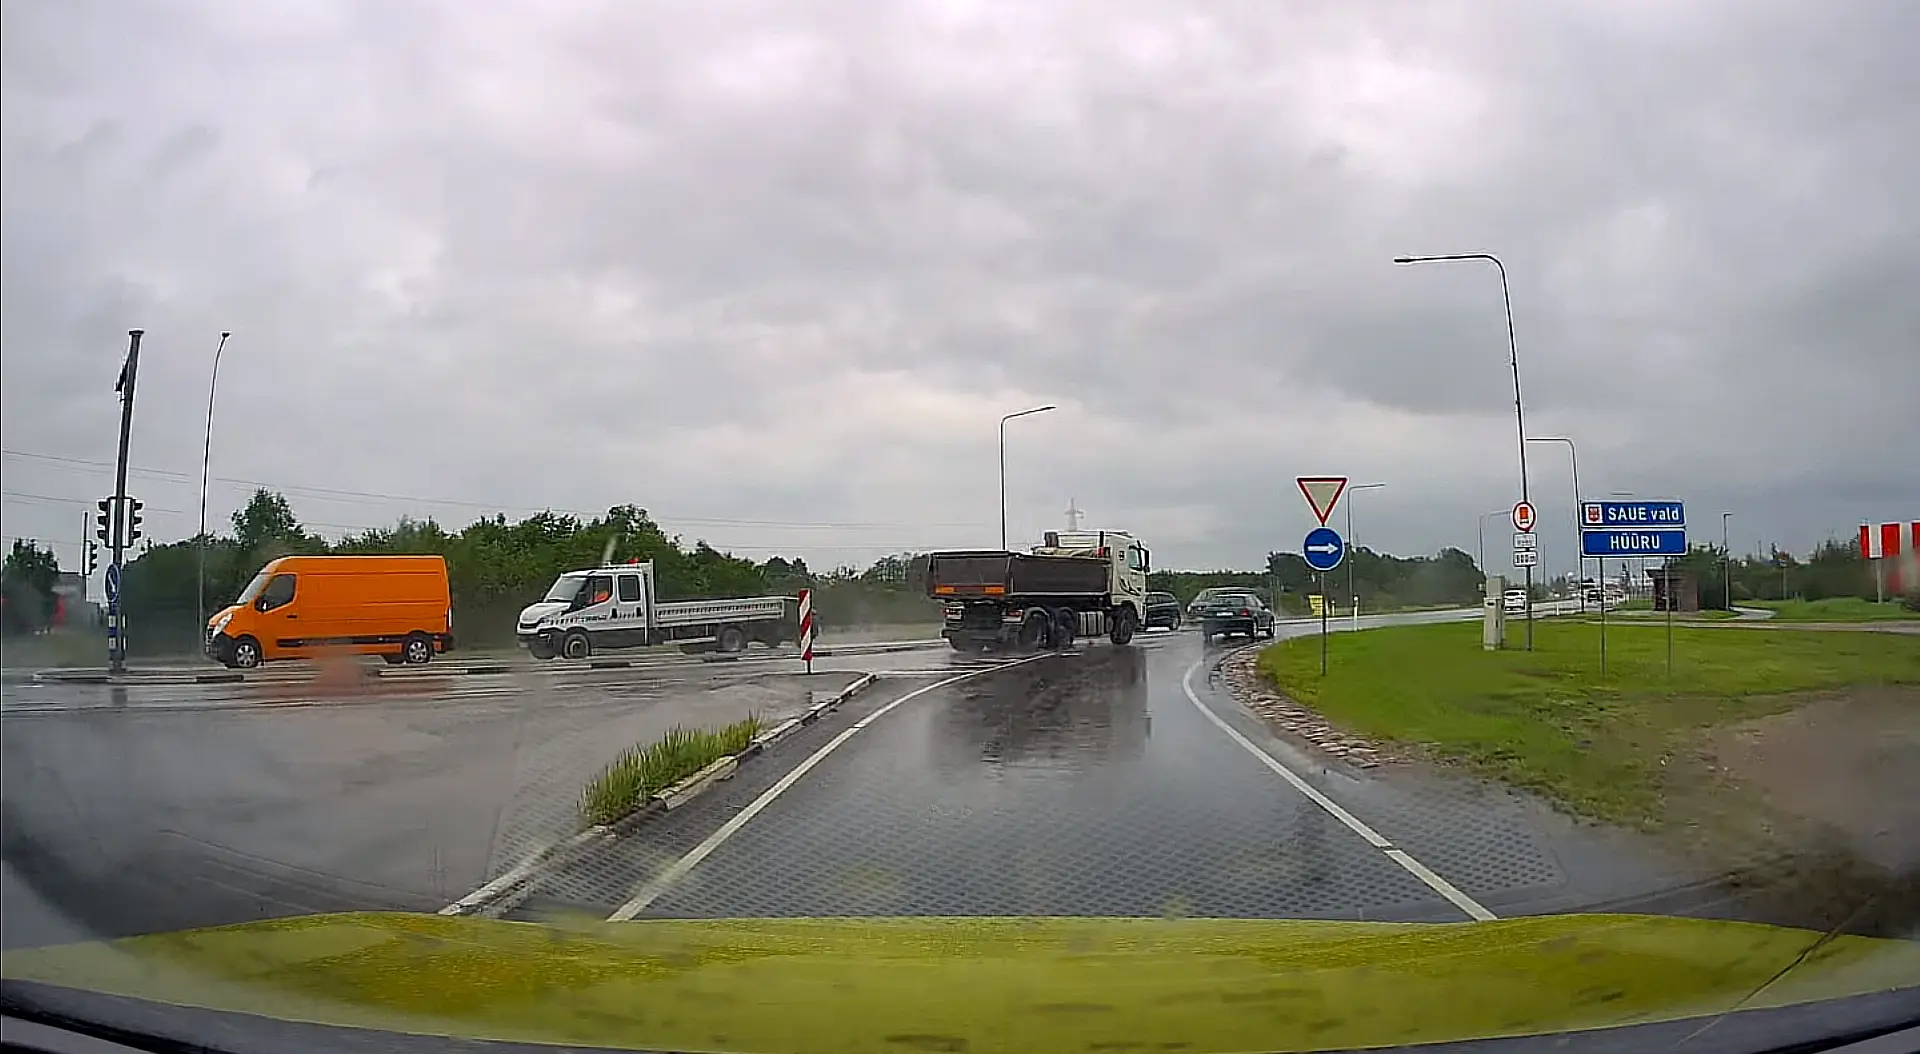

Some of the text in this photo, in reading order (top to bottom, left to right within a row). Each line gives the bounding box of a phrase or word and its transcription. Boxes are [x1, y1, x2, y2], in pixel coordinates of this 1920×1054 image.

[1608, 506, 1679, 521] SAUE vald
[1610, 532, 1660, 549] HÜÜRU
